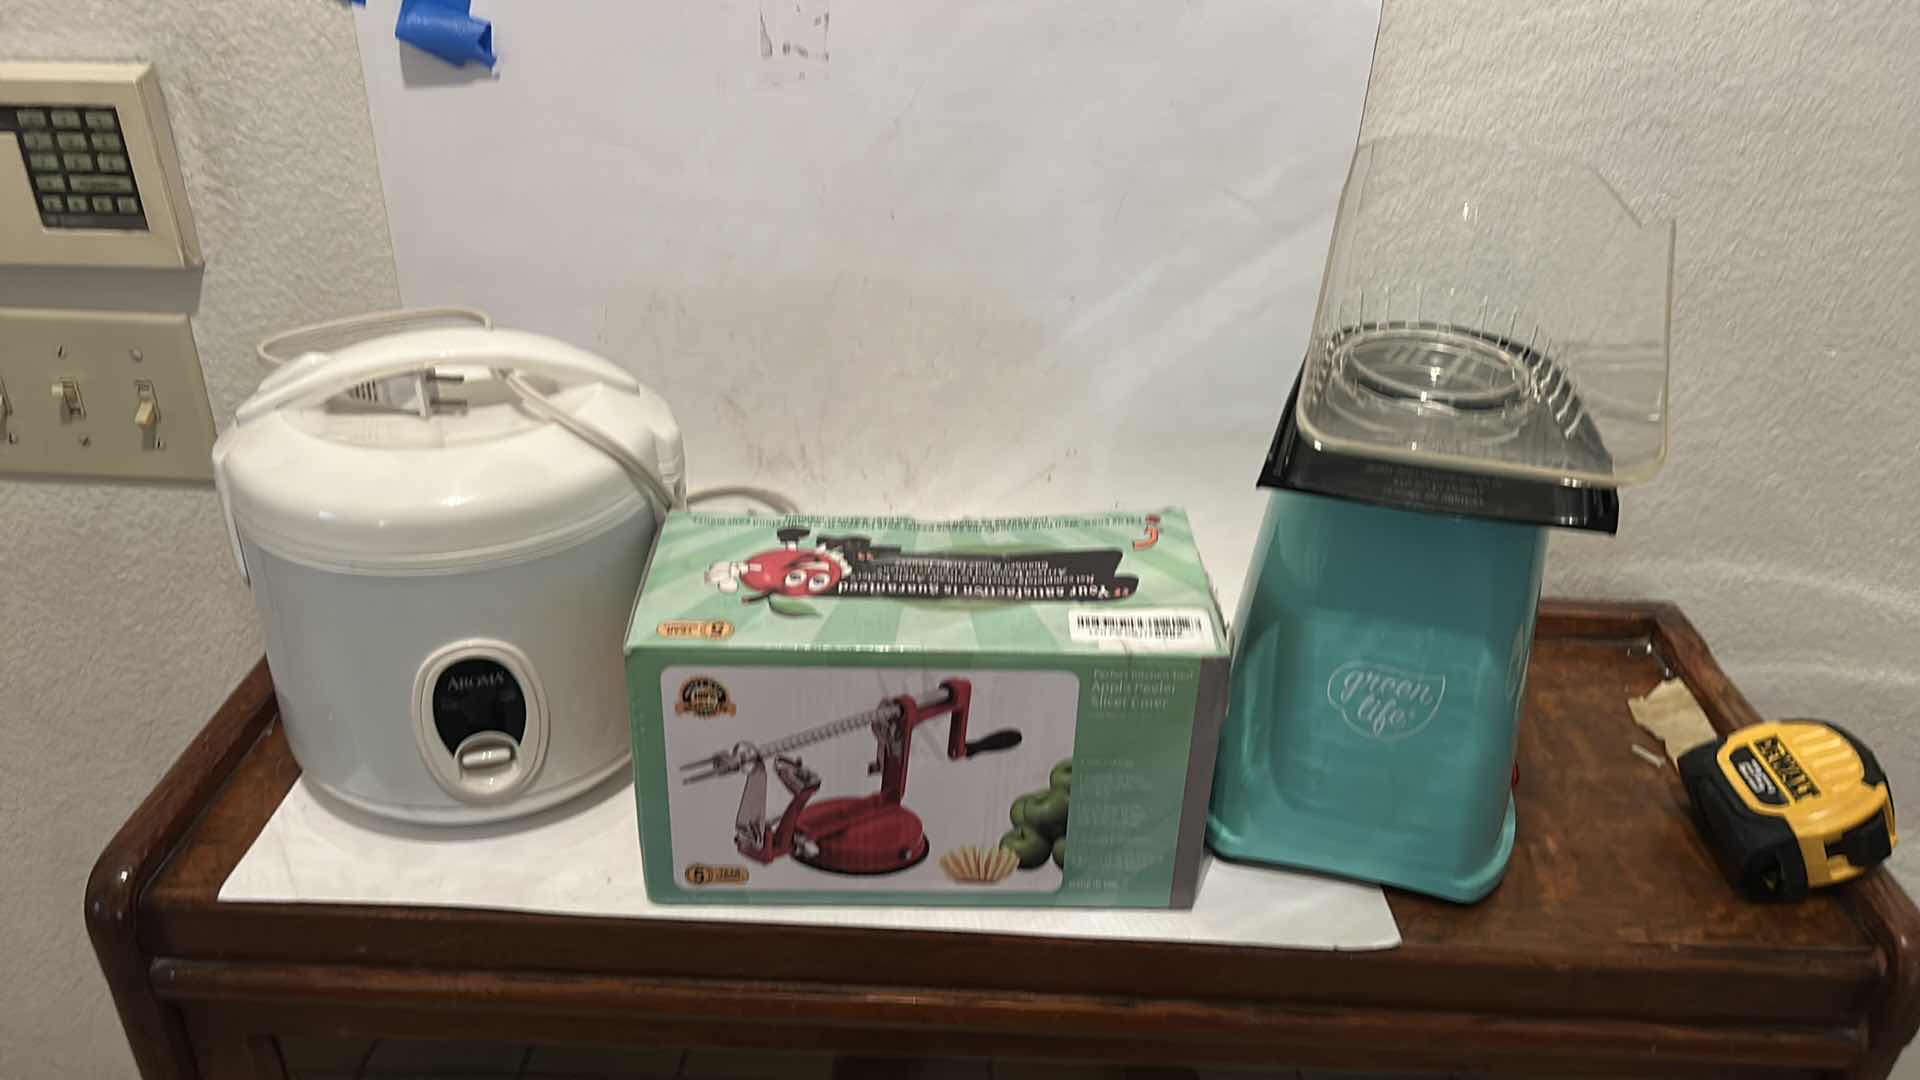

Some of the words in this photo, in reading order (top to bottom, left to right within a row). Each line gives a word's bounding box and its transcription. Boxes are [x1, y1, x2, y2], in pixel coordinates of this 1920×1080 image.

[1070, 584, 1109, 600] Your
[1340, 669, 1434, 705] green
[1357, 693, 1408, 737] life
